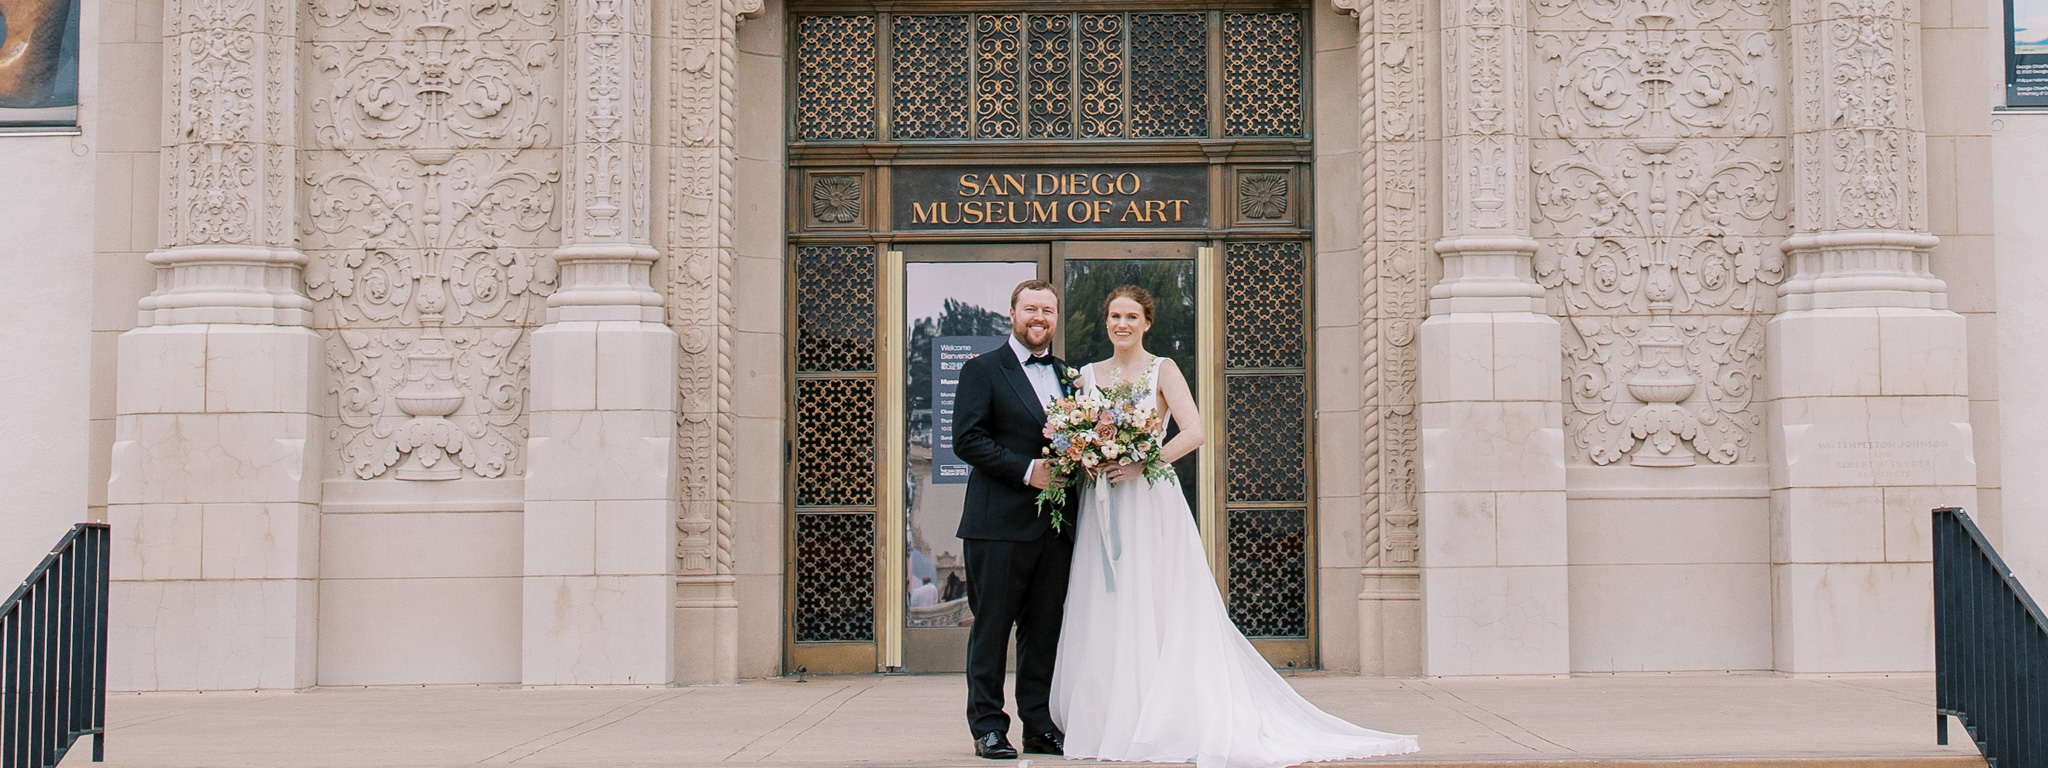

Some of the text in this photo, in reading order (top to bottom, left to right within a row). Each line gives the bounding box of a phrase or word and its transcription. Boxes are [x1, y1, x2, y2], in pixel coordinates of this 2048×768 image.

[959, 172, 1141, 197] SAN DIEGO
[911, 200, 1189, 224] MUSEUM OF ART
[1835, 441, 1895, 449] TEMPLETON
[1898, 440, 1948, 448] JOHNSON
[1836, 461, 1873, 469] ROBERT
[1890, 460, 1932, 468] SNYDER
